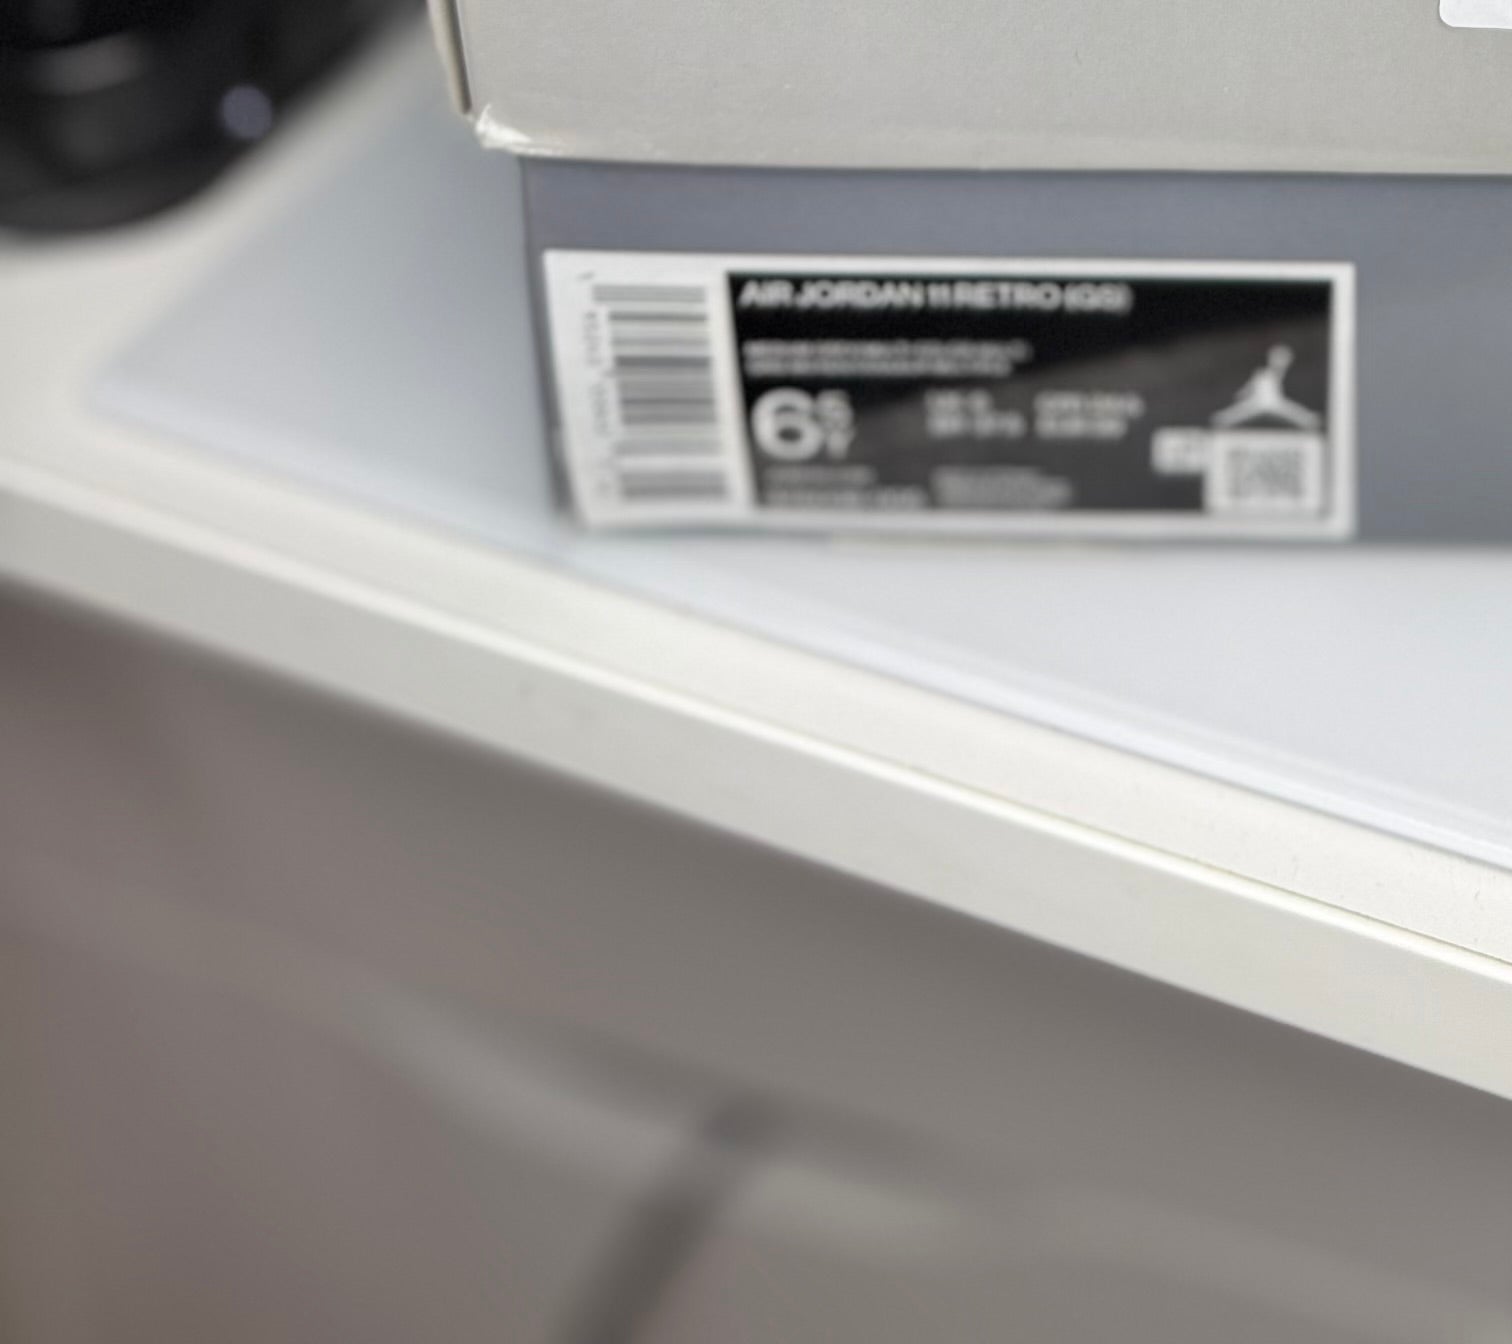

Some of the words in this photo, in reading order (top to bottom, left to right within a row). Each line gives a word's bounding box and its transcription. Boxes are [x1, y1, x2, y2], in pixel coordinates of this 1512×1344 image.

[738, 279, 795, 308] AIR
[795, 279, 926, 310] JORDAN
[953, 281, 1063, 311] RETRO
